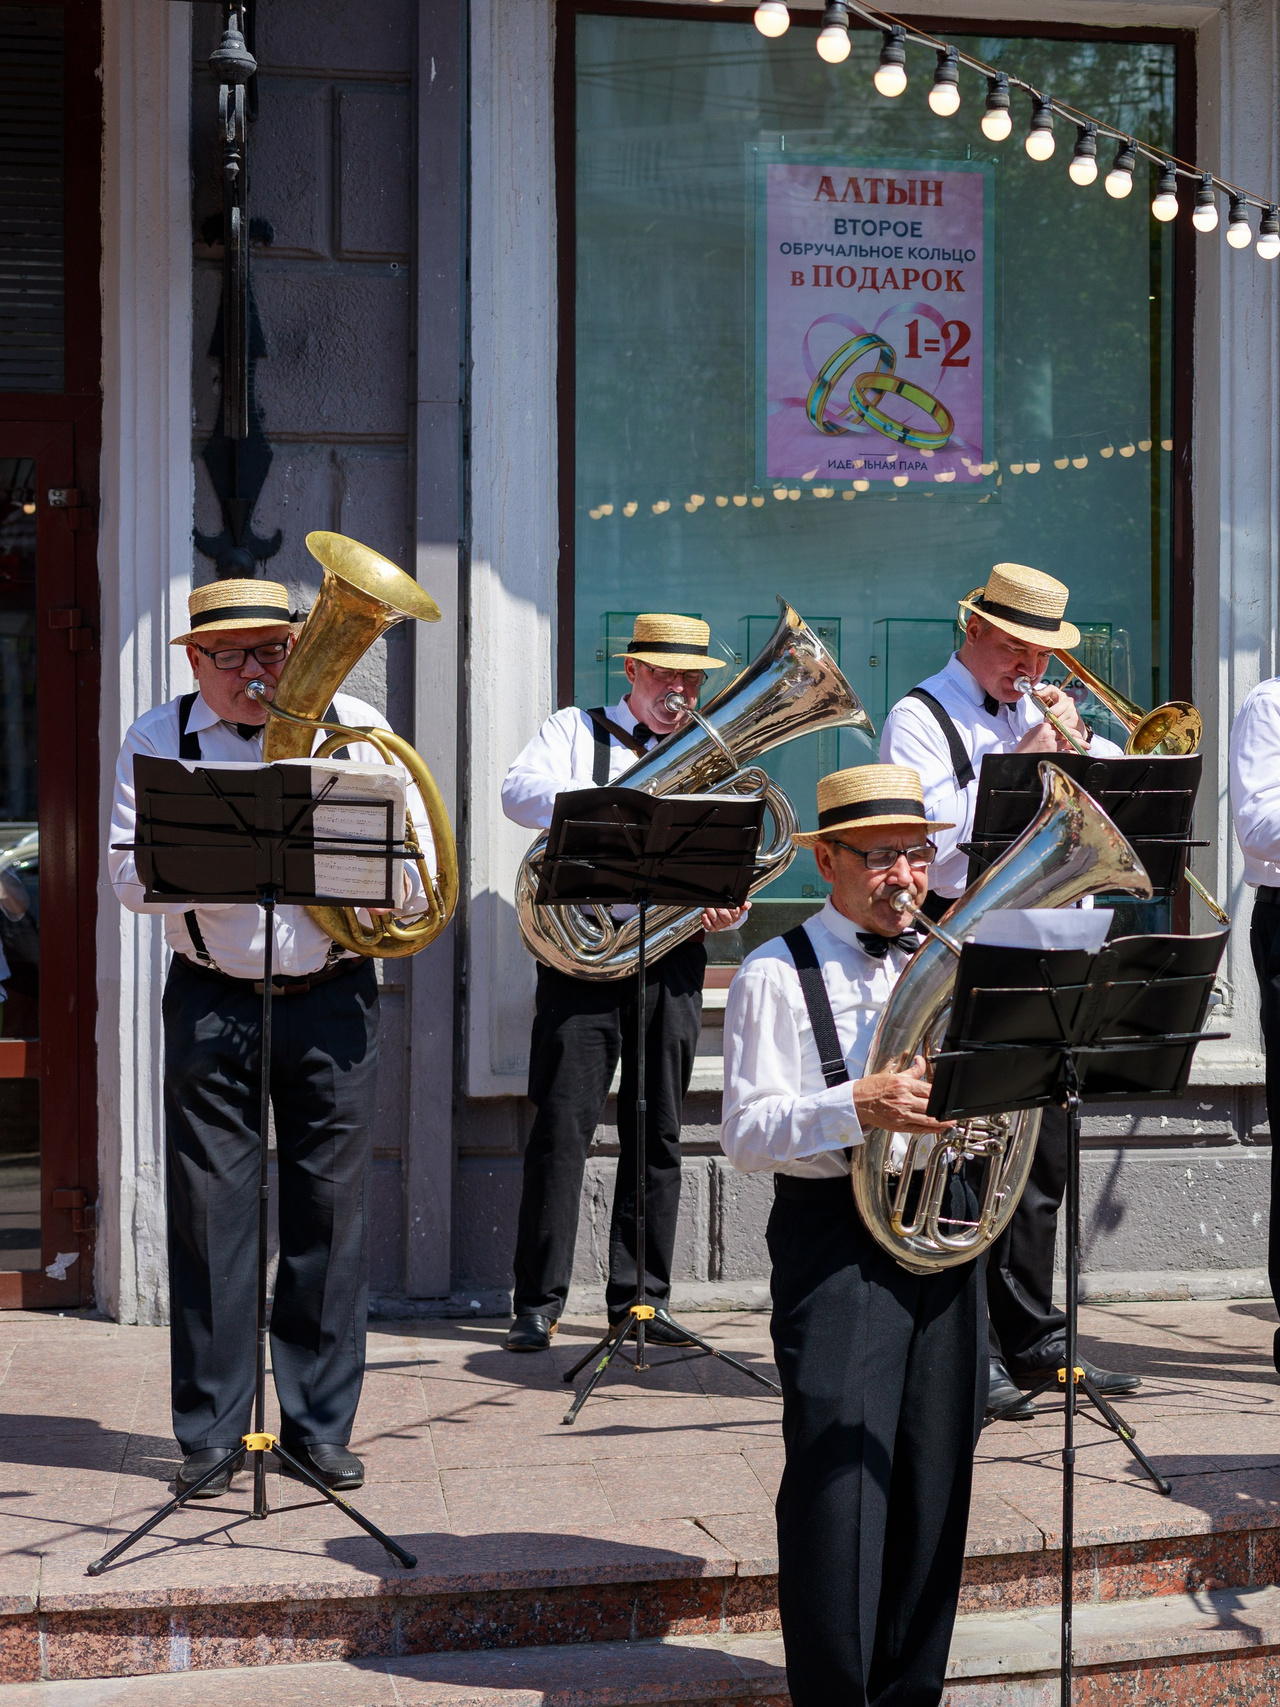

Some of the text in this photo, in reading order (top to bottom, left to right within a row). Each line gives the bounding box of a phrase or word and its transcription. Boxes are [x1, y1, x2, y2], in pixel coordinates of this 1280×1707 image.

[813, 176, 944, 206] АЛТЫН
[834, 218, 923, 238] ВТОРОЕ
[779, 242, 977, 263] ОБРУЧАЛЬНОЕ КОЛЬЦО
[811, 264, 966, 294] ПОДАРОК
[828, 459, 929, 471] ИДЕЛЬНАЯ ПАРА
